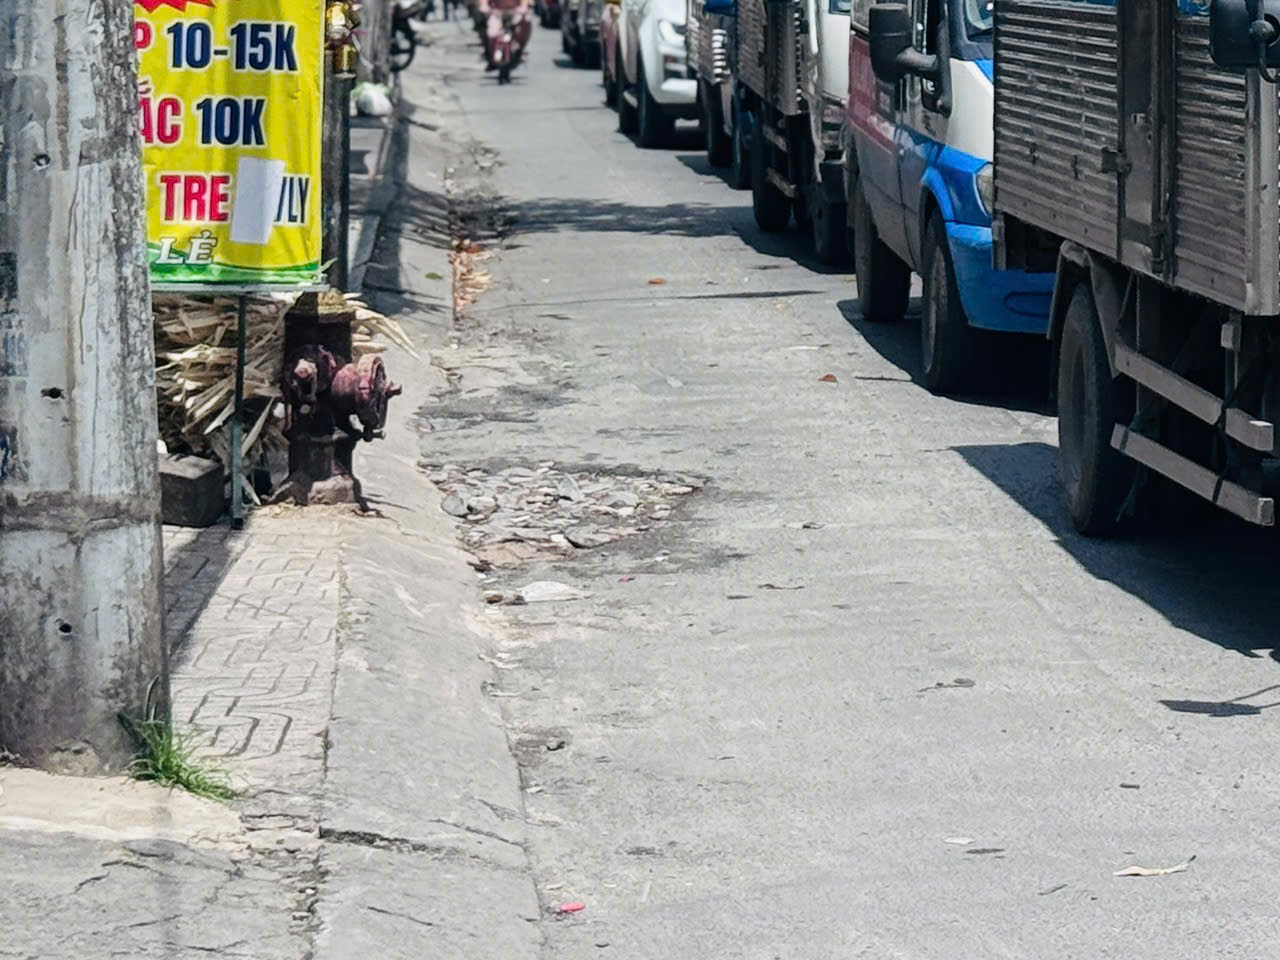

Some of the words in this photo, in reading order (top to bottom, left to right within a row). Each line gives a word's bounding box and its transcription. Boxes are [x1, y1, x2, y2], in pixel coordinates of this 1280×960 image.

[167, 21, 298, 72] 10-15K
[196, 97, 266, 146] 10K
[160, 174, 231, 222] TRE
